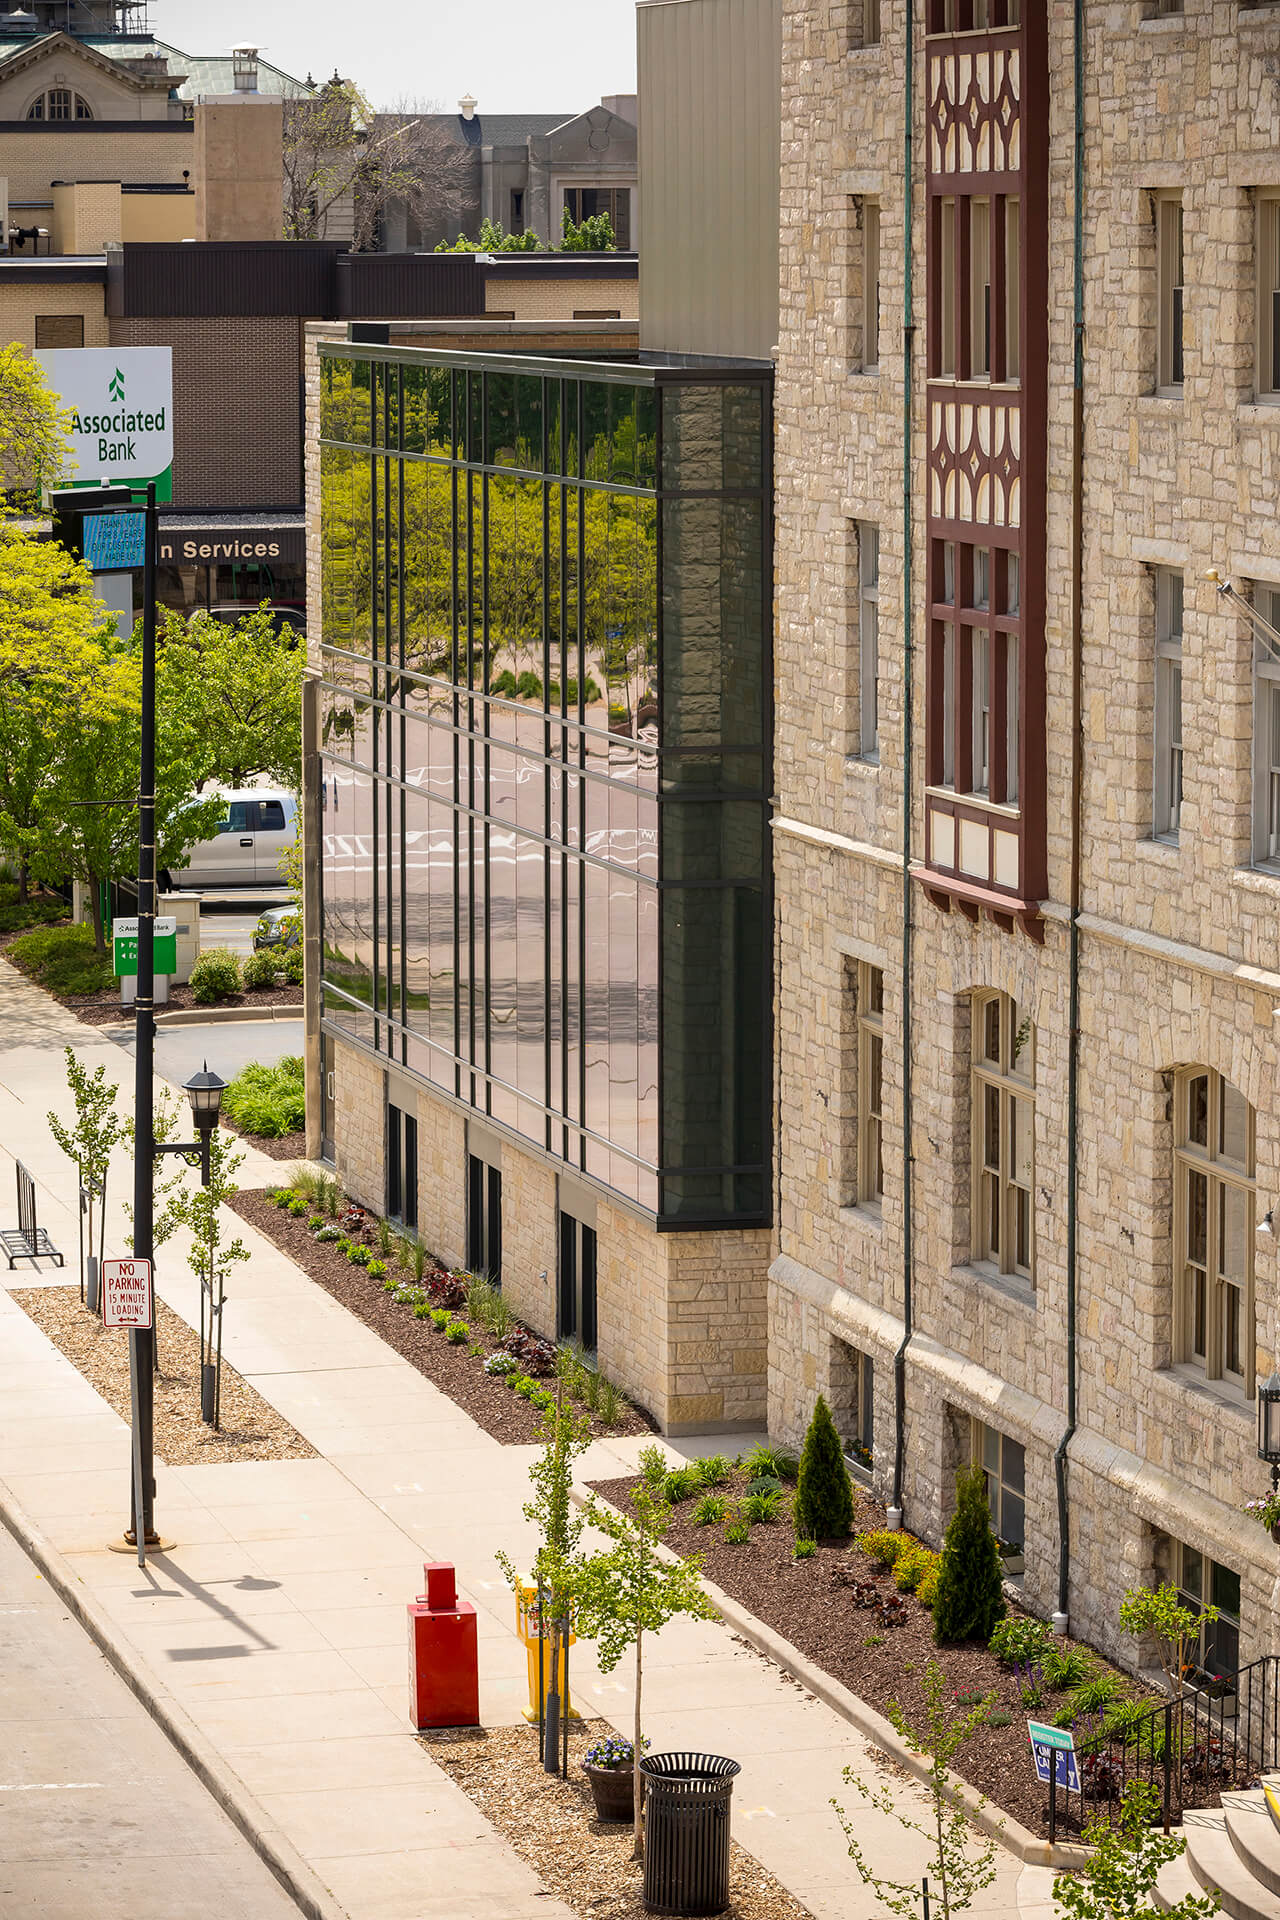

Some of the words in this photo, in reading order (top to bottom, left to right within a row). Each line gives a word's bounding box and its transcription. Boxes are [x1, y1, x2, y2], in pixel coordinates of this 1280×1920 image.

[72, 407, 165, 434] Associated
[98, 436, 136, 461] Bank
[100, 519, 120, 529] THANK
[183, 540, 280, 558] Services
[119, 1263, 135, 1276] NO
[108, 1278, 145, 1290] PARKING
[109, 1294, 117, 1304] 15
[120, 1293, 145, 1304] MINUTE
[111, 1305, 144, 1315] LOADING
